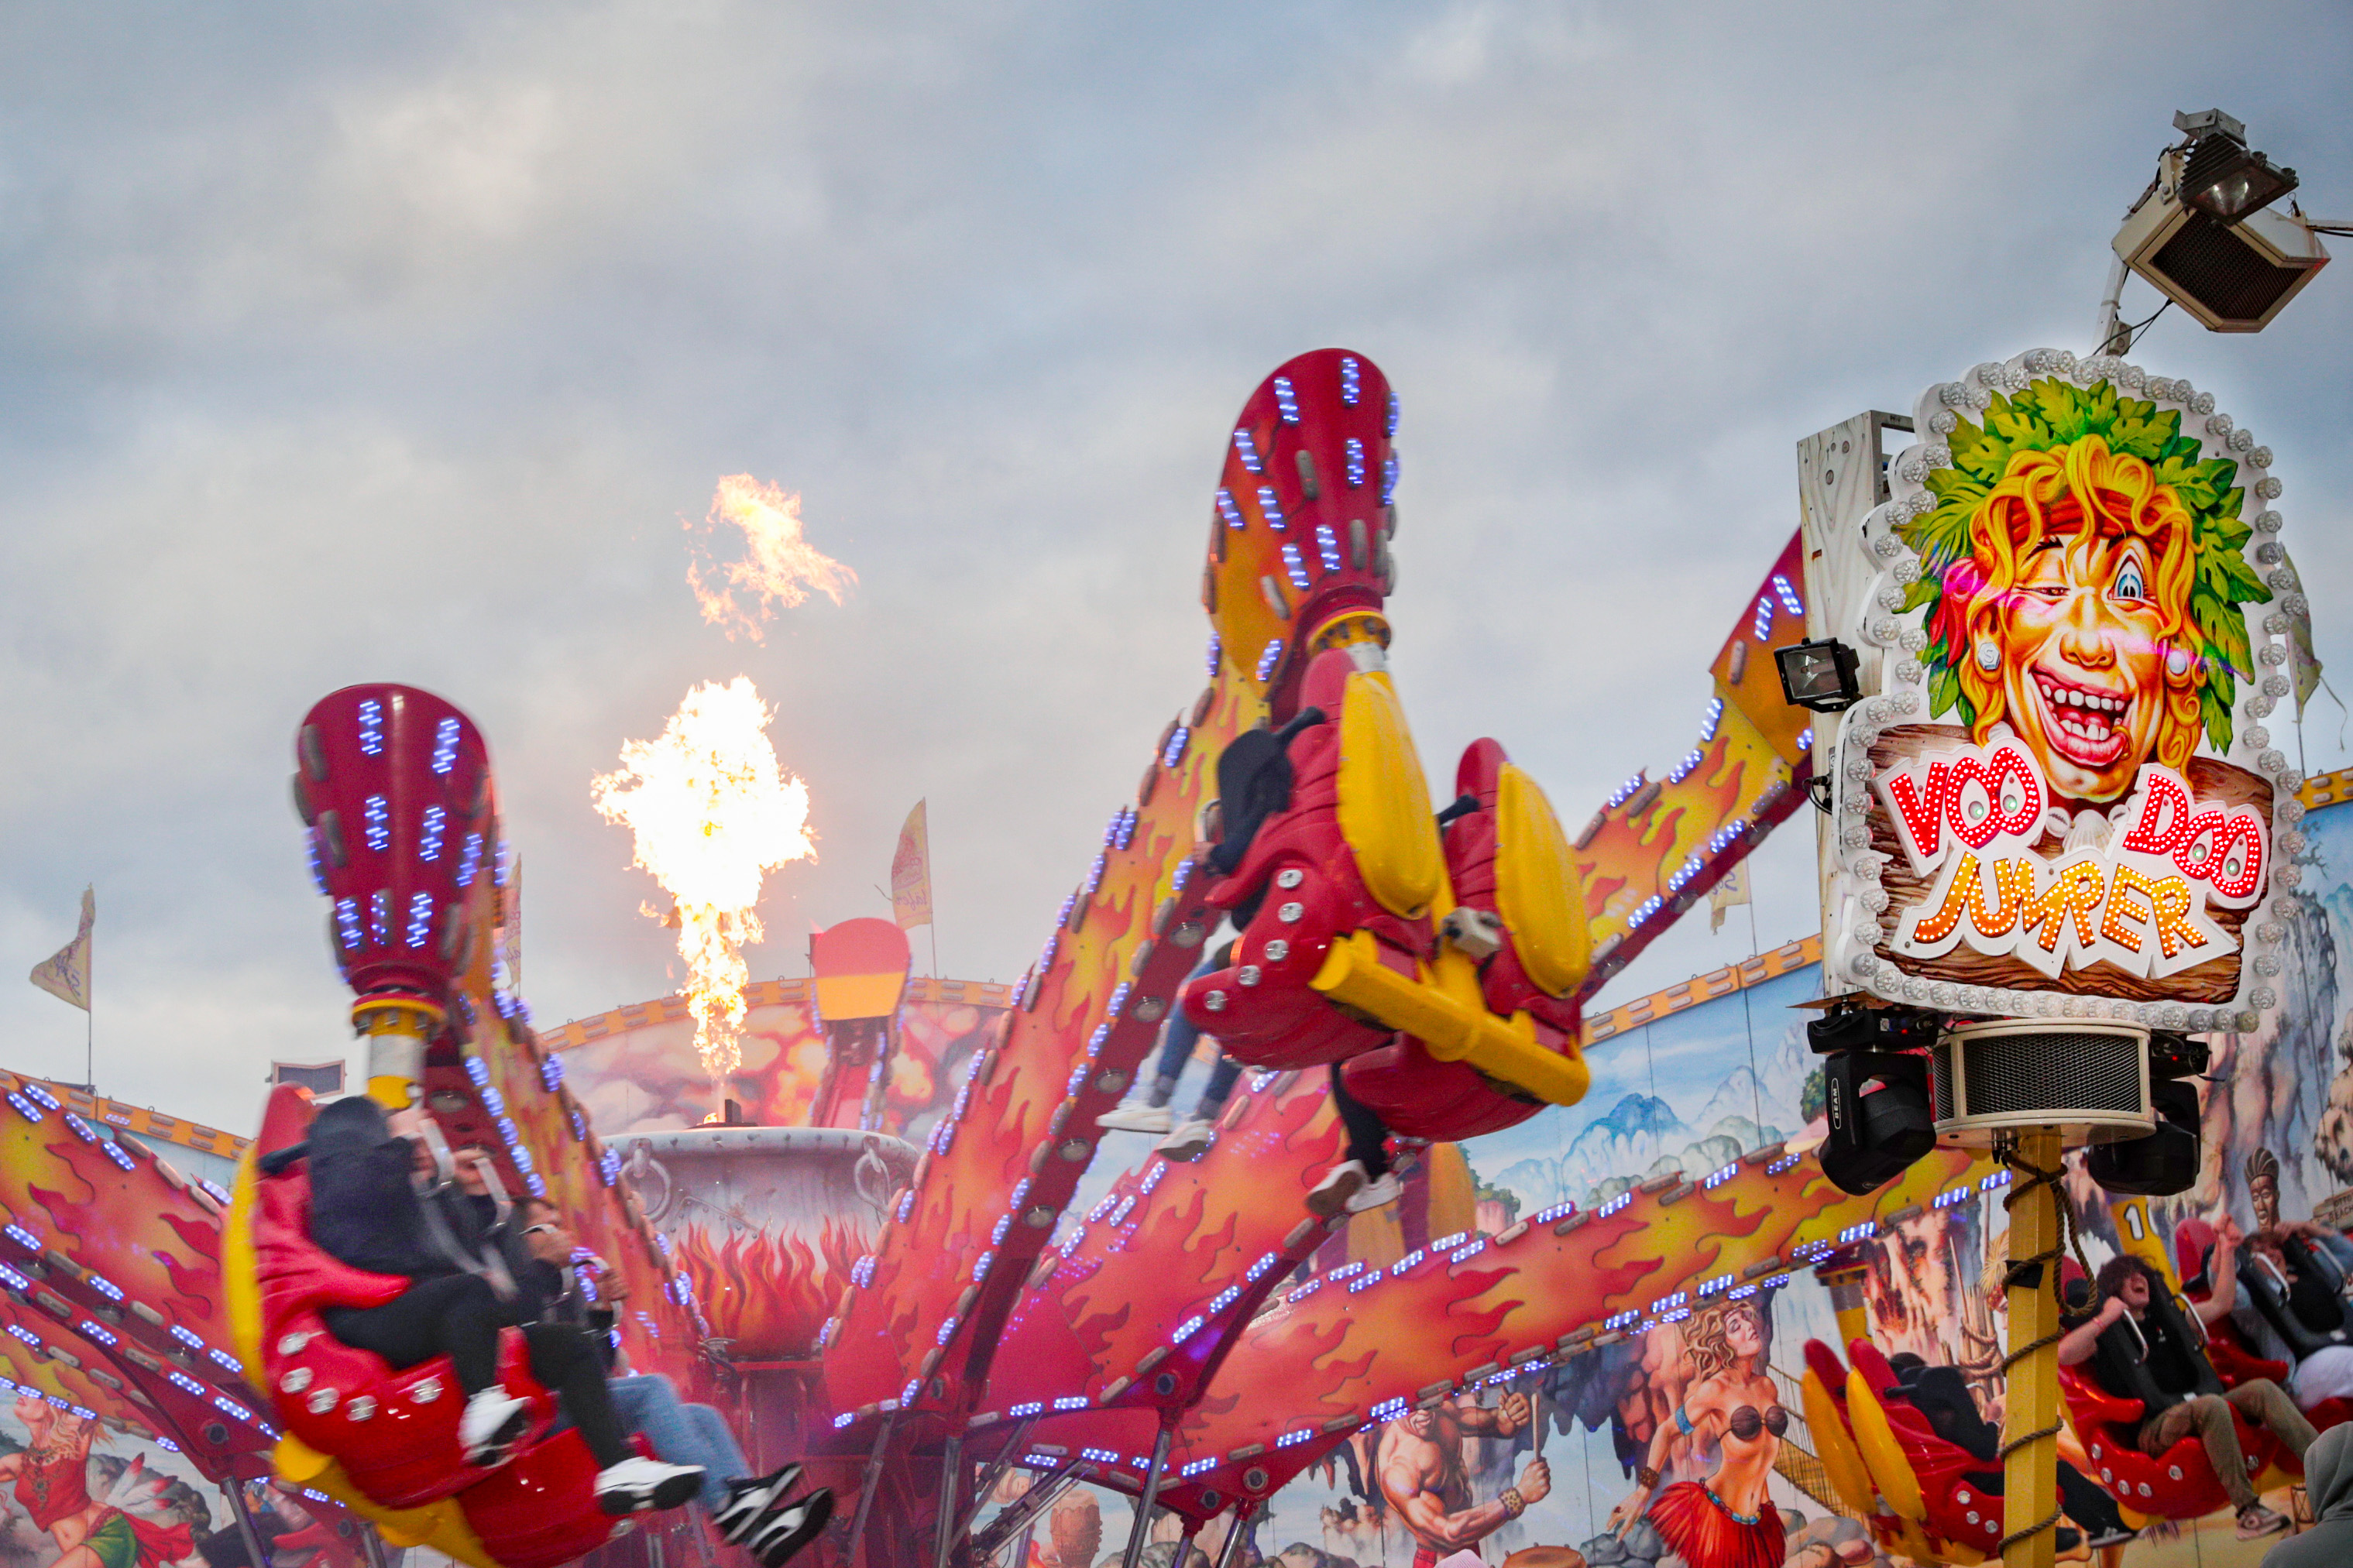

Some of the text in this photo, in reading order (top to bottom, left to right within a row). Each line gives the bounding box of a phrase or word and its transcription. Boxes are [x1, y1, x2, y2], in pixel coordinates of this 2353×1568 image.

[1890, 746, 2262, 897] VOO DOO
[1913, 852, 2209, 959] JUMPER
